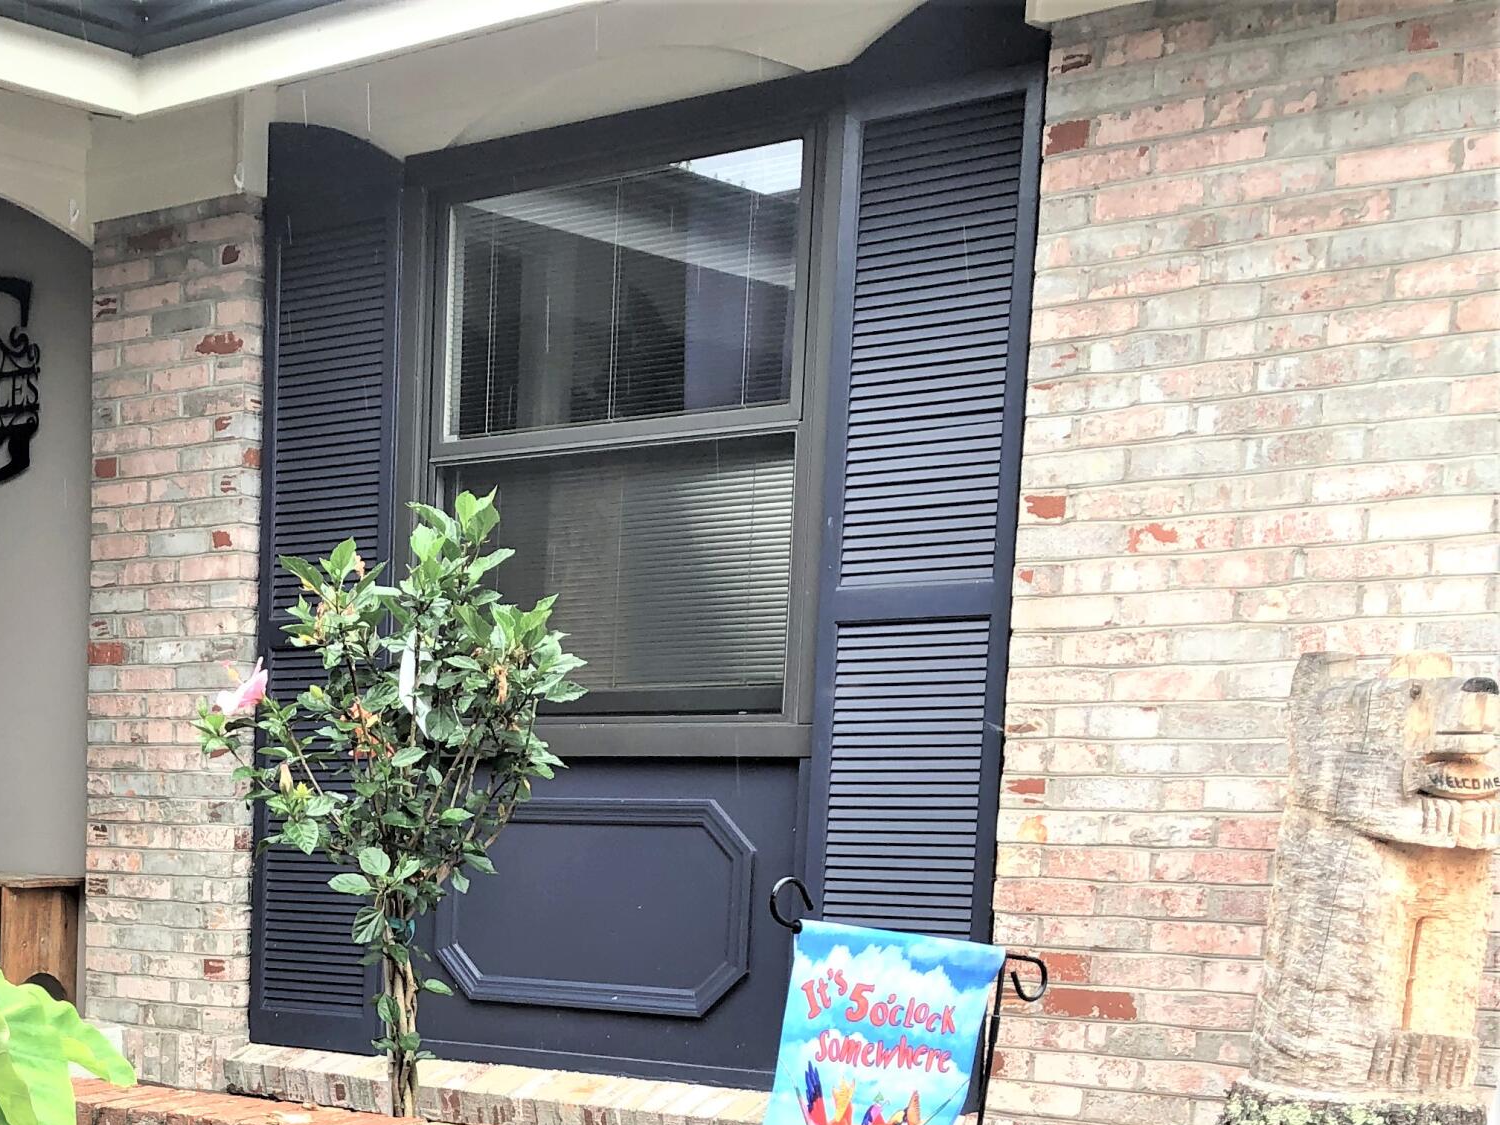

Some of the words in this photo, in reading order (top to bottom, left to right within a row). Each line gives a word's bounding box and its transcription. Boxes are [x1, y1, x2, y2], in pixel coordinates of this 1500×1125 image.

[1428, 774, 1500, 790] WELCOME
[801, 968, 848, 1019] It's
[845, 983, 875, 1022] 5
